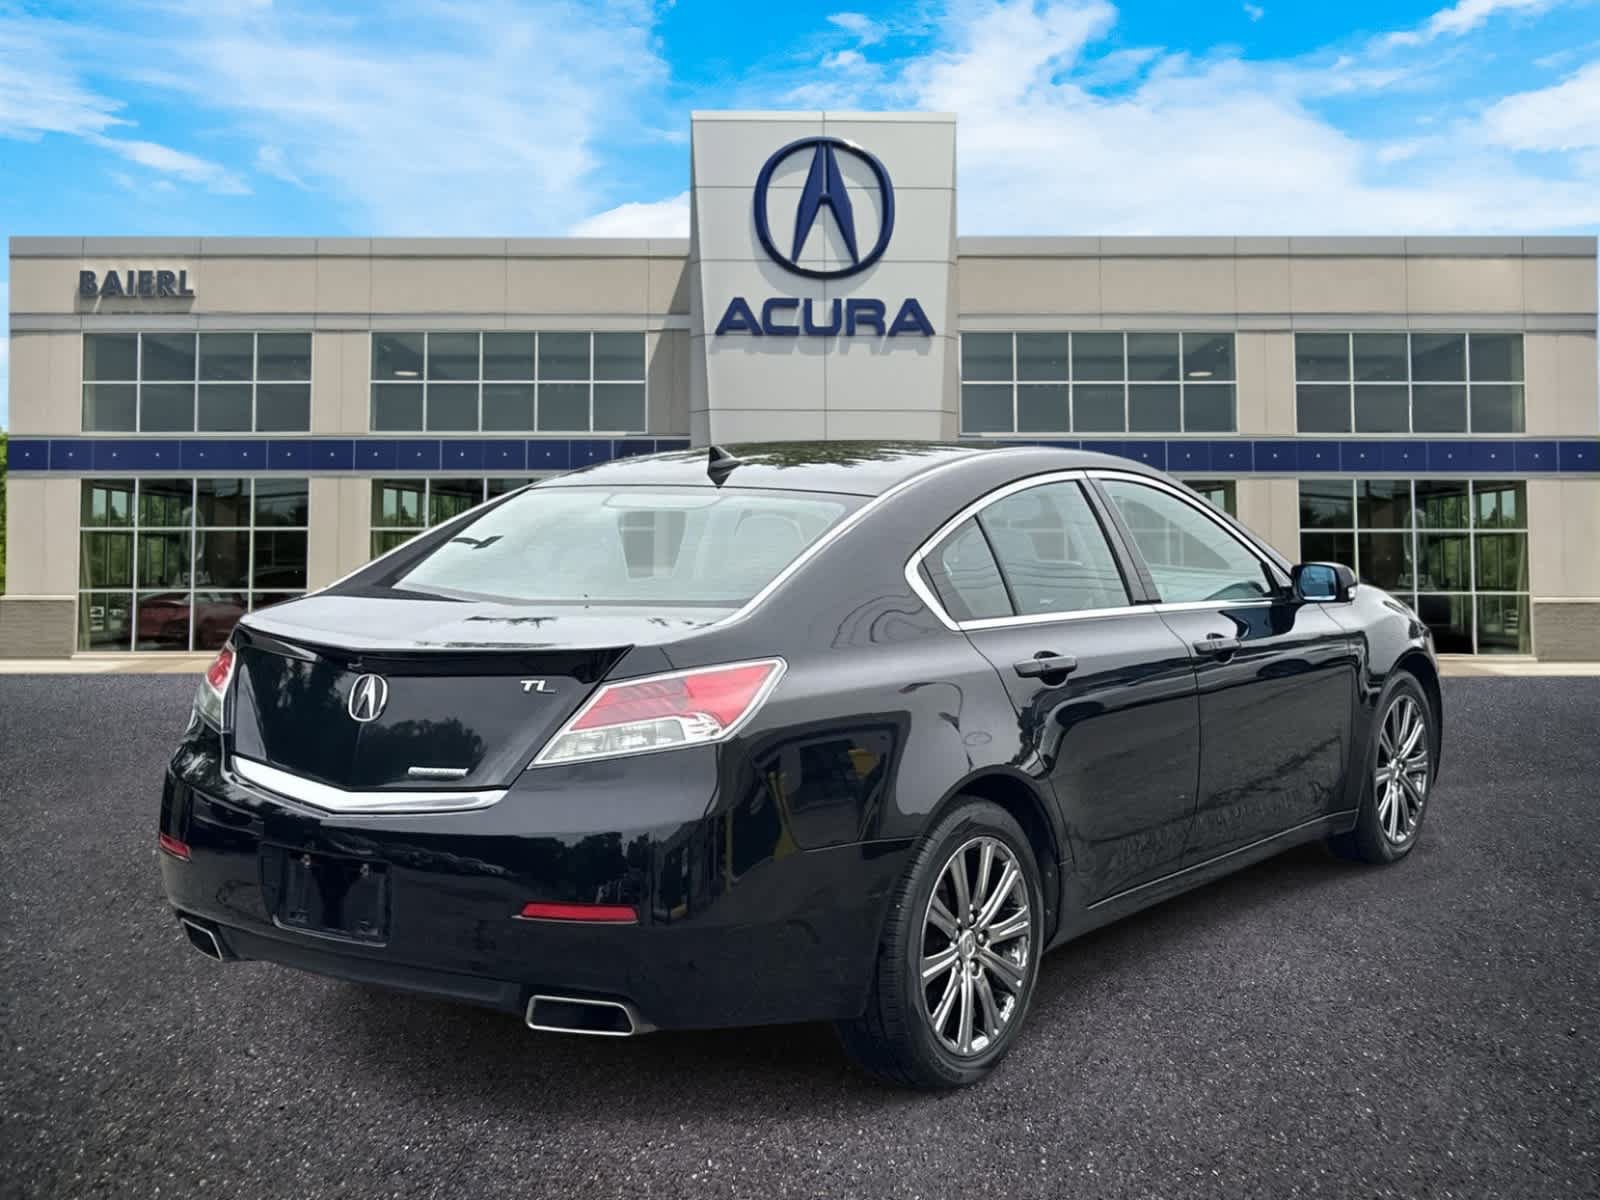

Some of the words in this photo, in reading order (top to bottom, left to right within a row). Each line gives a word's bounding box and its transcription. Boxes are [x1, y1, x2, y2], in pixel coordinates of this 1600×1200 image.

[79, 270, 194, 296] BAIERL
[714, 297, 936, 337] ACURA
[520, 680, 555, 692] TL
